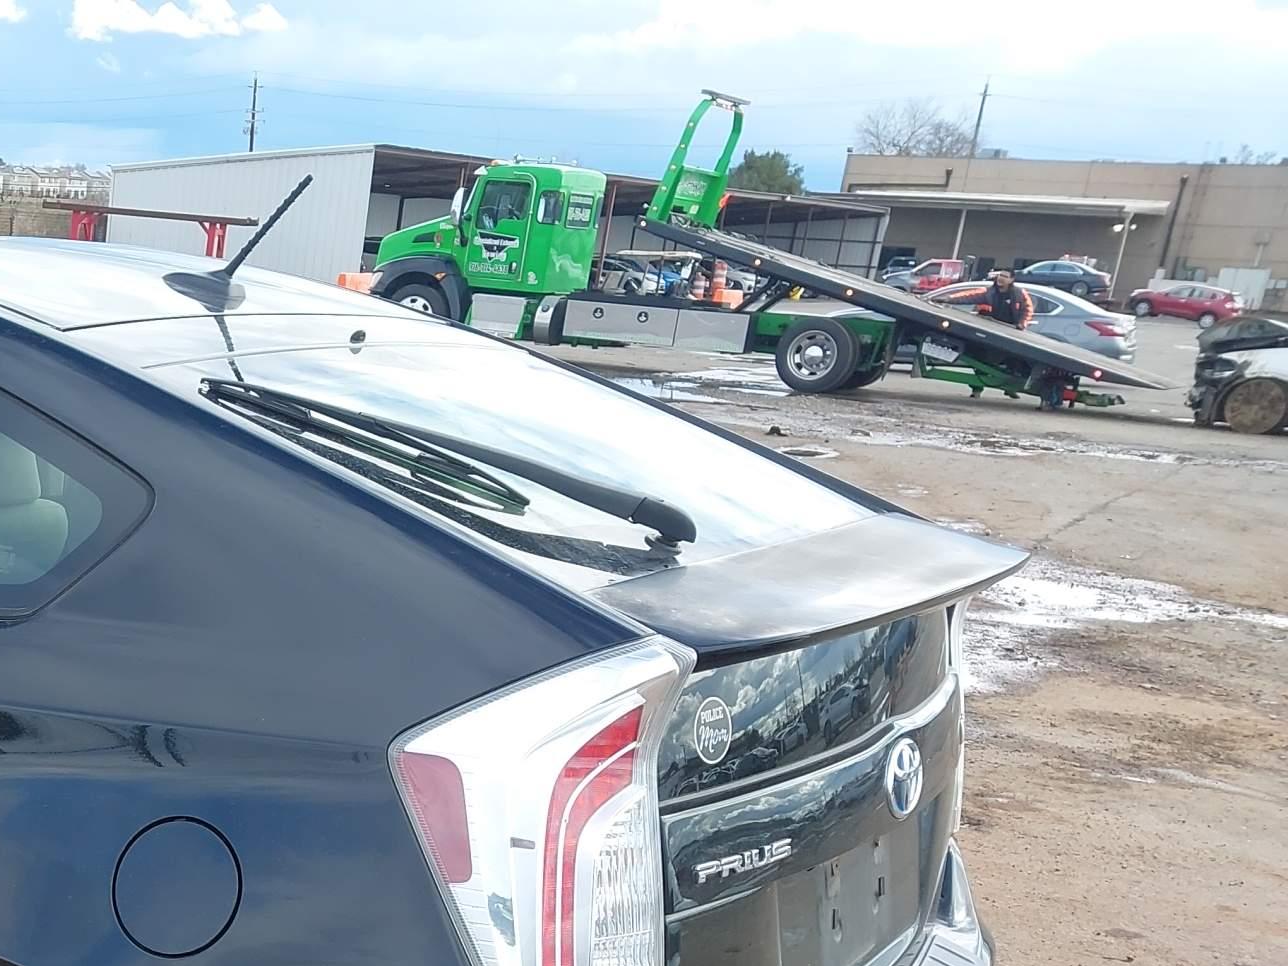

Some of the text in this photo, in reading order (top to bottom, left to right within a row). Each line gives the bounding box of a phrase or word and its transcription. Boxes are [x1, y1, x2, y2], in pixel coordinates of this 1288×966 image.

[700, 706, 724, 724] POLICE
[698, 725, 729, 753] Mom
[692, 838, 792, 884] PRIUS
